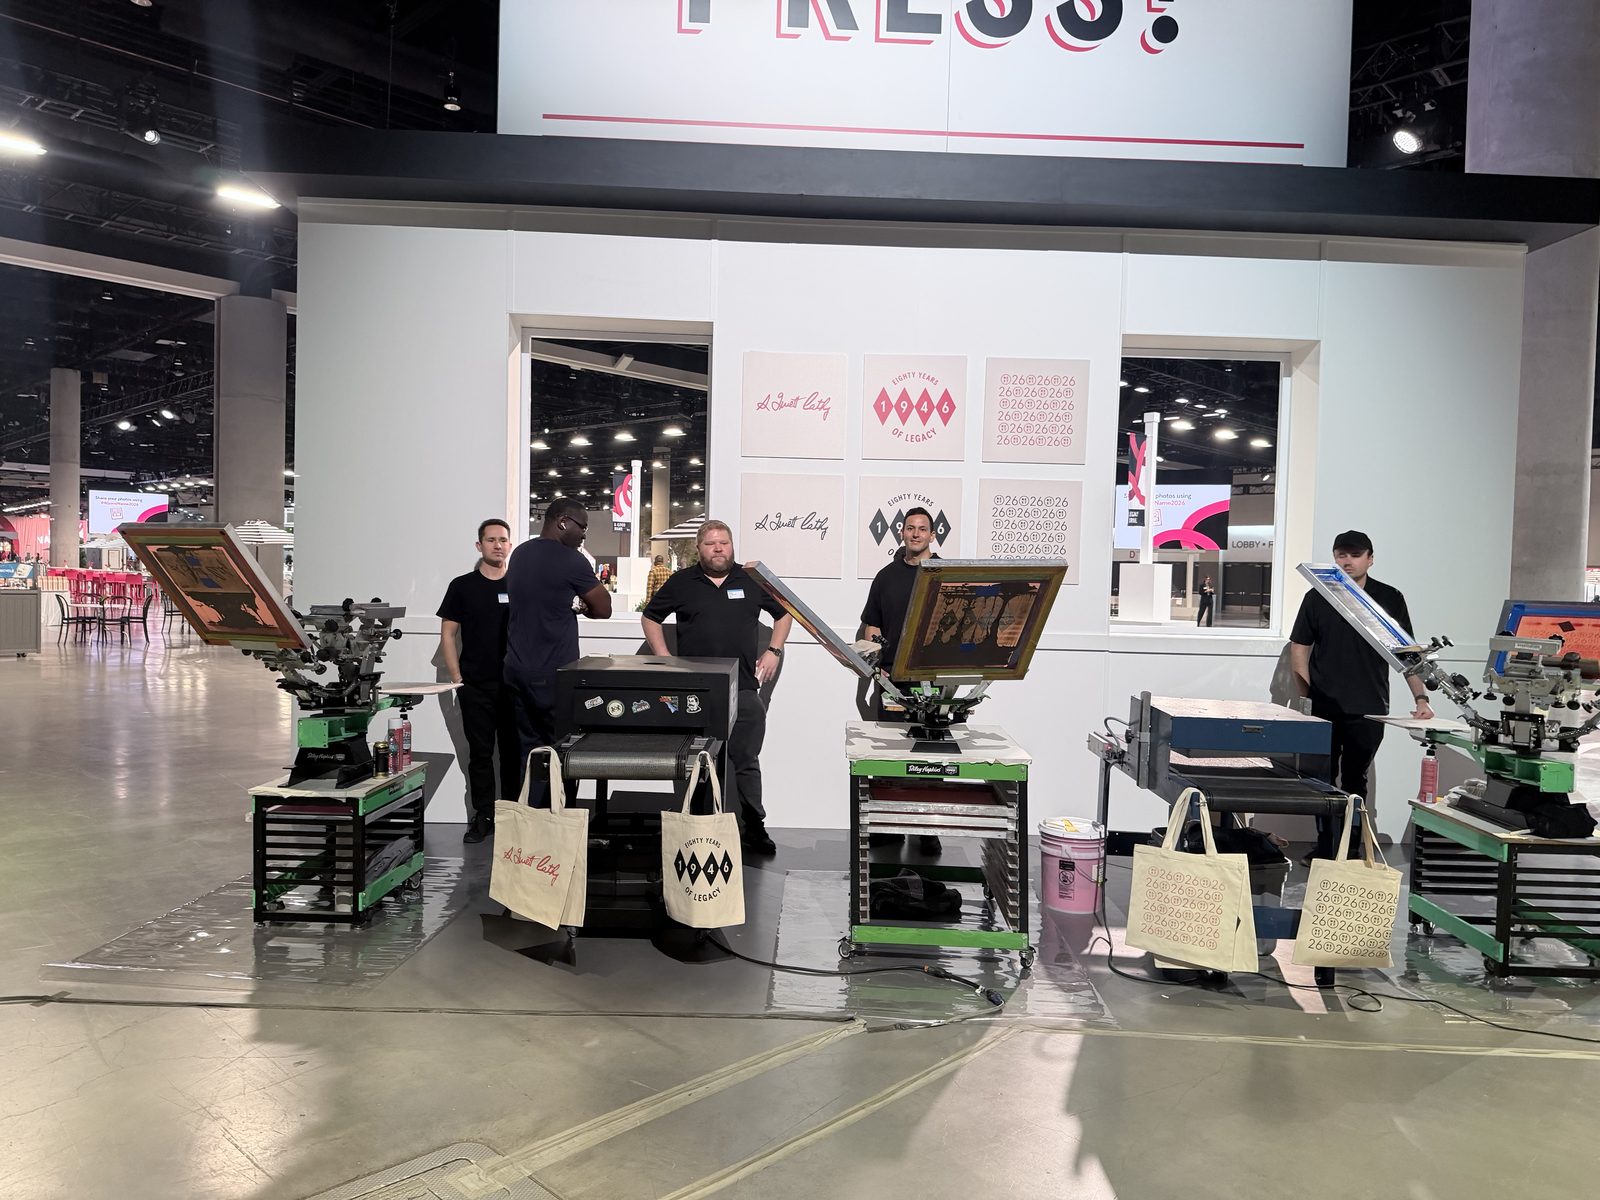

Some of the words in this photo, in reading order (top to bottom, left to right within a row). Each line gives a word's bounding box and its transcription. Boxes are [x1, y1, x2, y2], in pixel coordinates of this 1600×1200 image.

[892, 372, 915, 385] EIGHTY
[919, 372, 939, 385] YEARS
[892, 428, 903, 438] OF
[905, 428, 936, 442] LEGACY
[888, 494, 911, 506] EIGHTY
[914, 494, 934, 506] YEARS
[685, 838, 703, 848] EIGHTY
[706, 838, 720, 848] YEARS
[685, 887, 692, 896] OF
[694, 887, 720, 901] LEGACY
